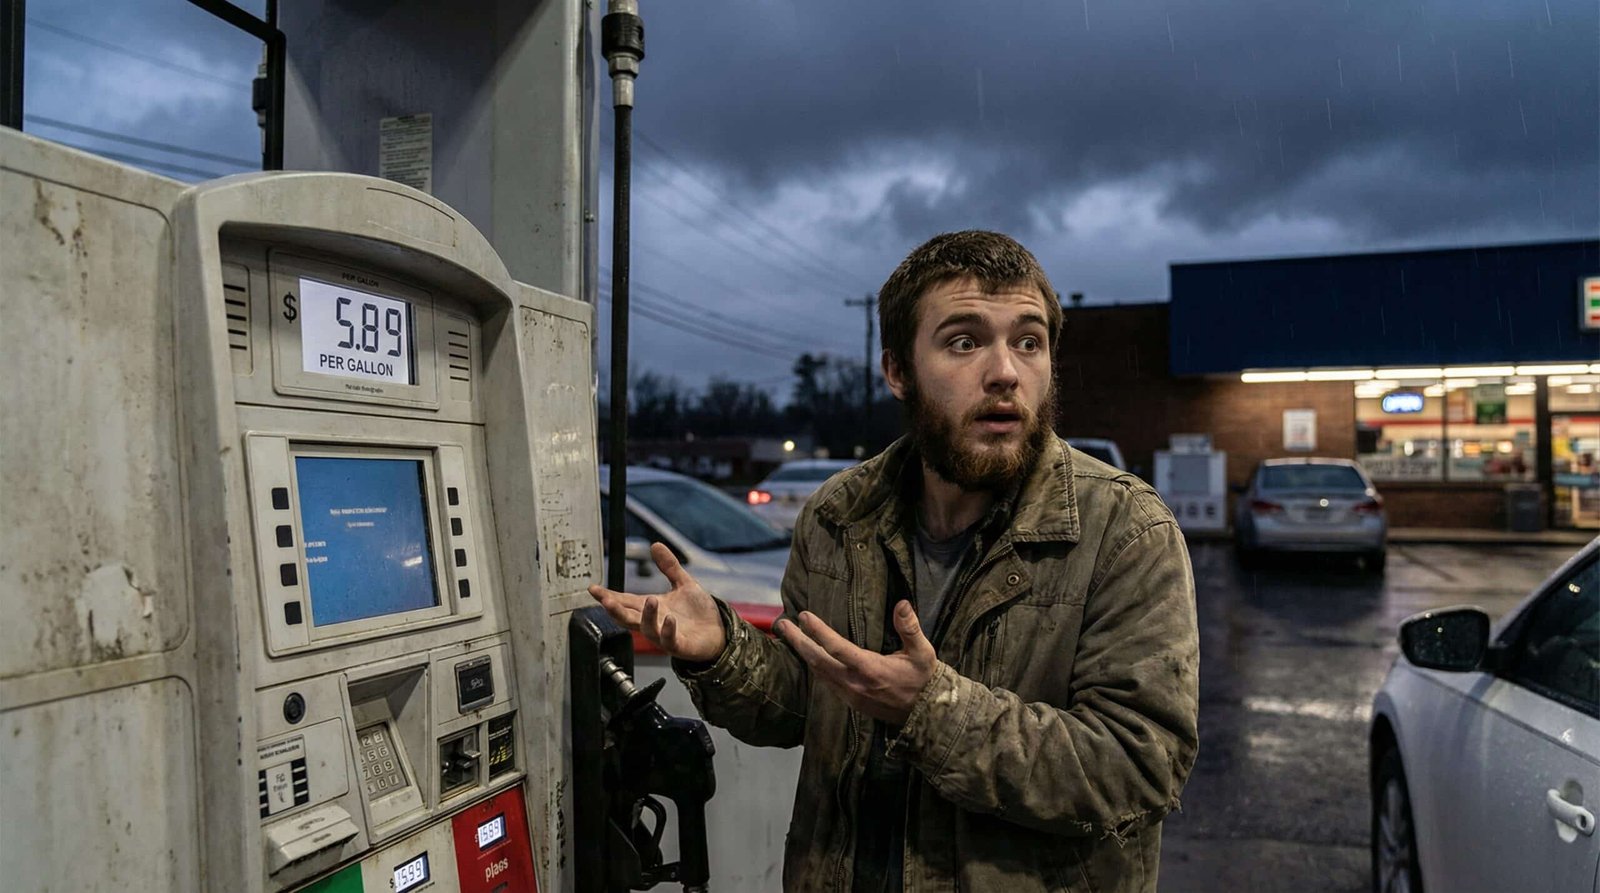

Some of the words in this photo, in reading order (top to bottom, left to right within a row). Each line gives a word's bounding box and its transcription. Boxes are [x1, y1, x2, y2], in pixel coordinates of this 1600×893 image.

[283, 292, 297, 323] $
[336, 297, 401, 357] 5.89
[320, 354, 344, 370] PER
[347, 358, 393, 376] GALLON
